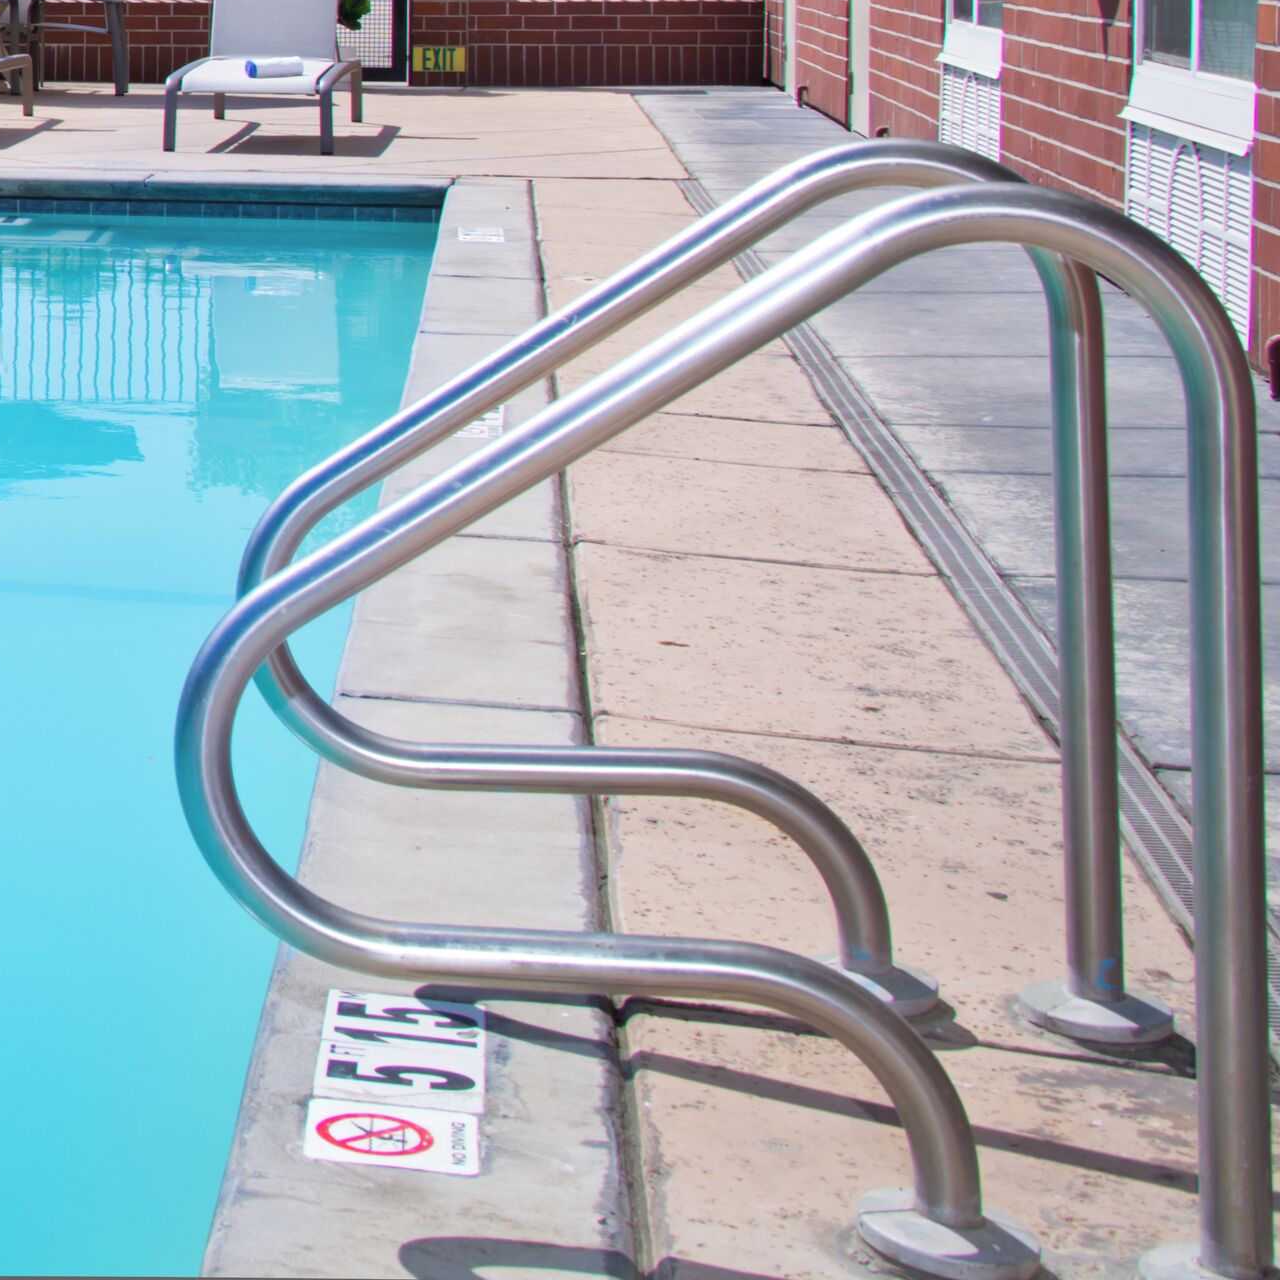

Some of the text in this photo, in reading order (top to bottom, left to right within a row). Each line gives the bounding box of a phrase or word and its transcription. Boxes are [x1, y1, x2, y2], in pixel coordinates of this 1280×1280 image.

[423, 47, 456, 71] EXIT
[326, 1044, 477, 1091] 5 FT
[450, 1122, 467, 1166] NO DIVING
